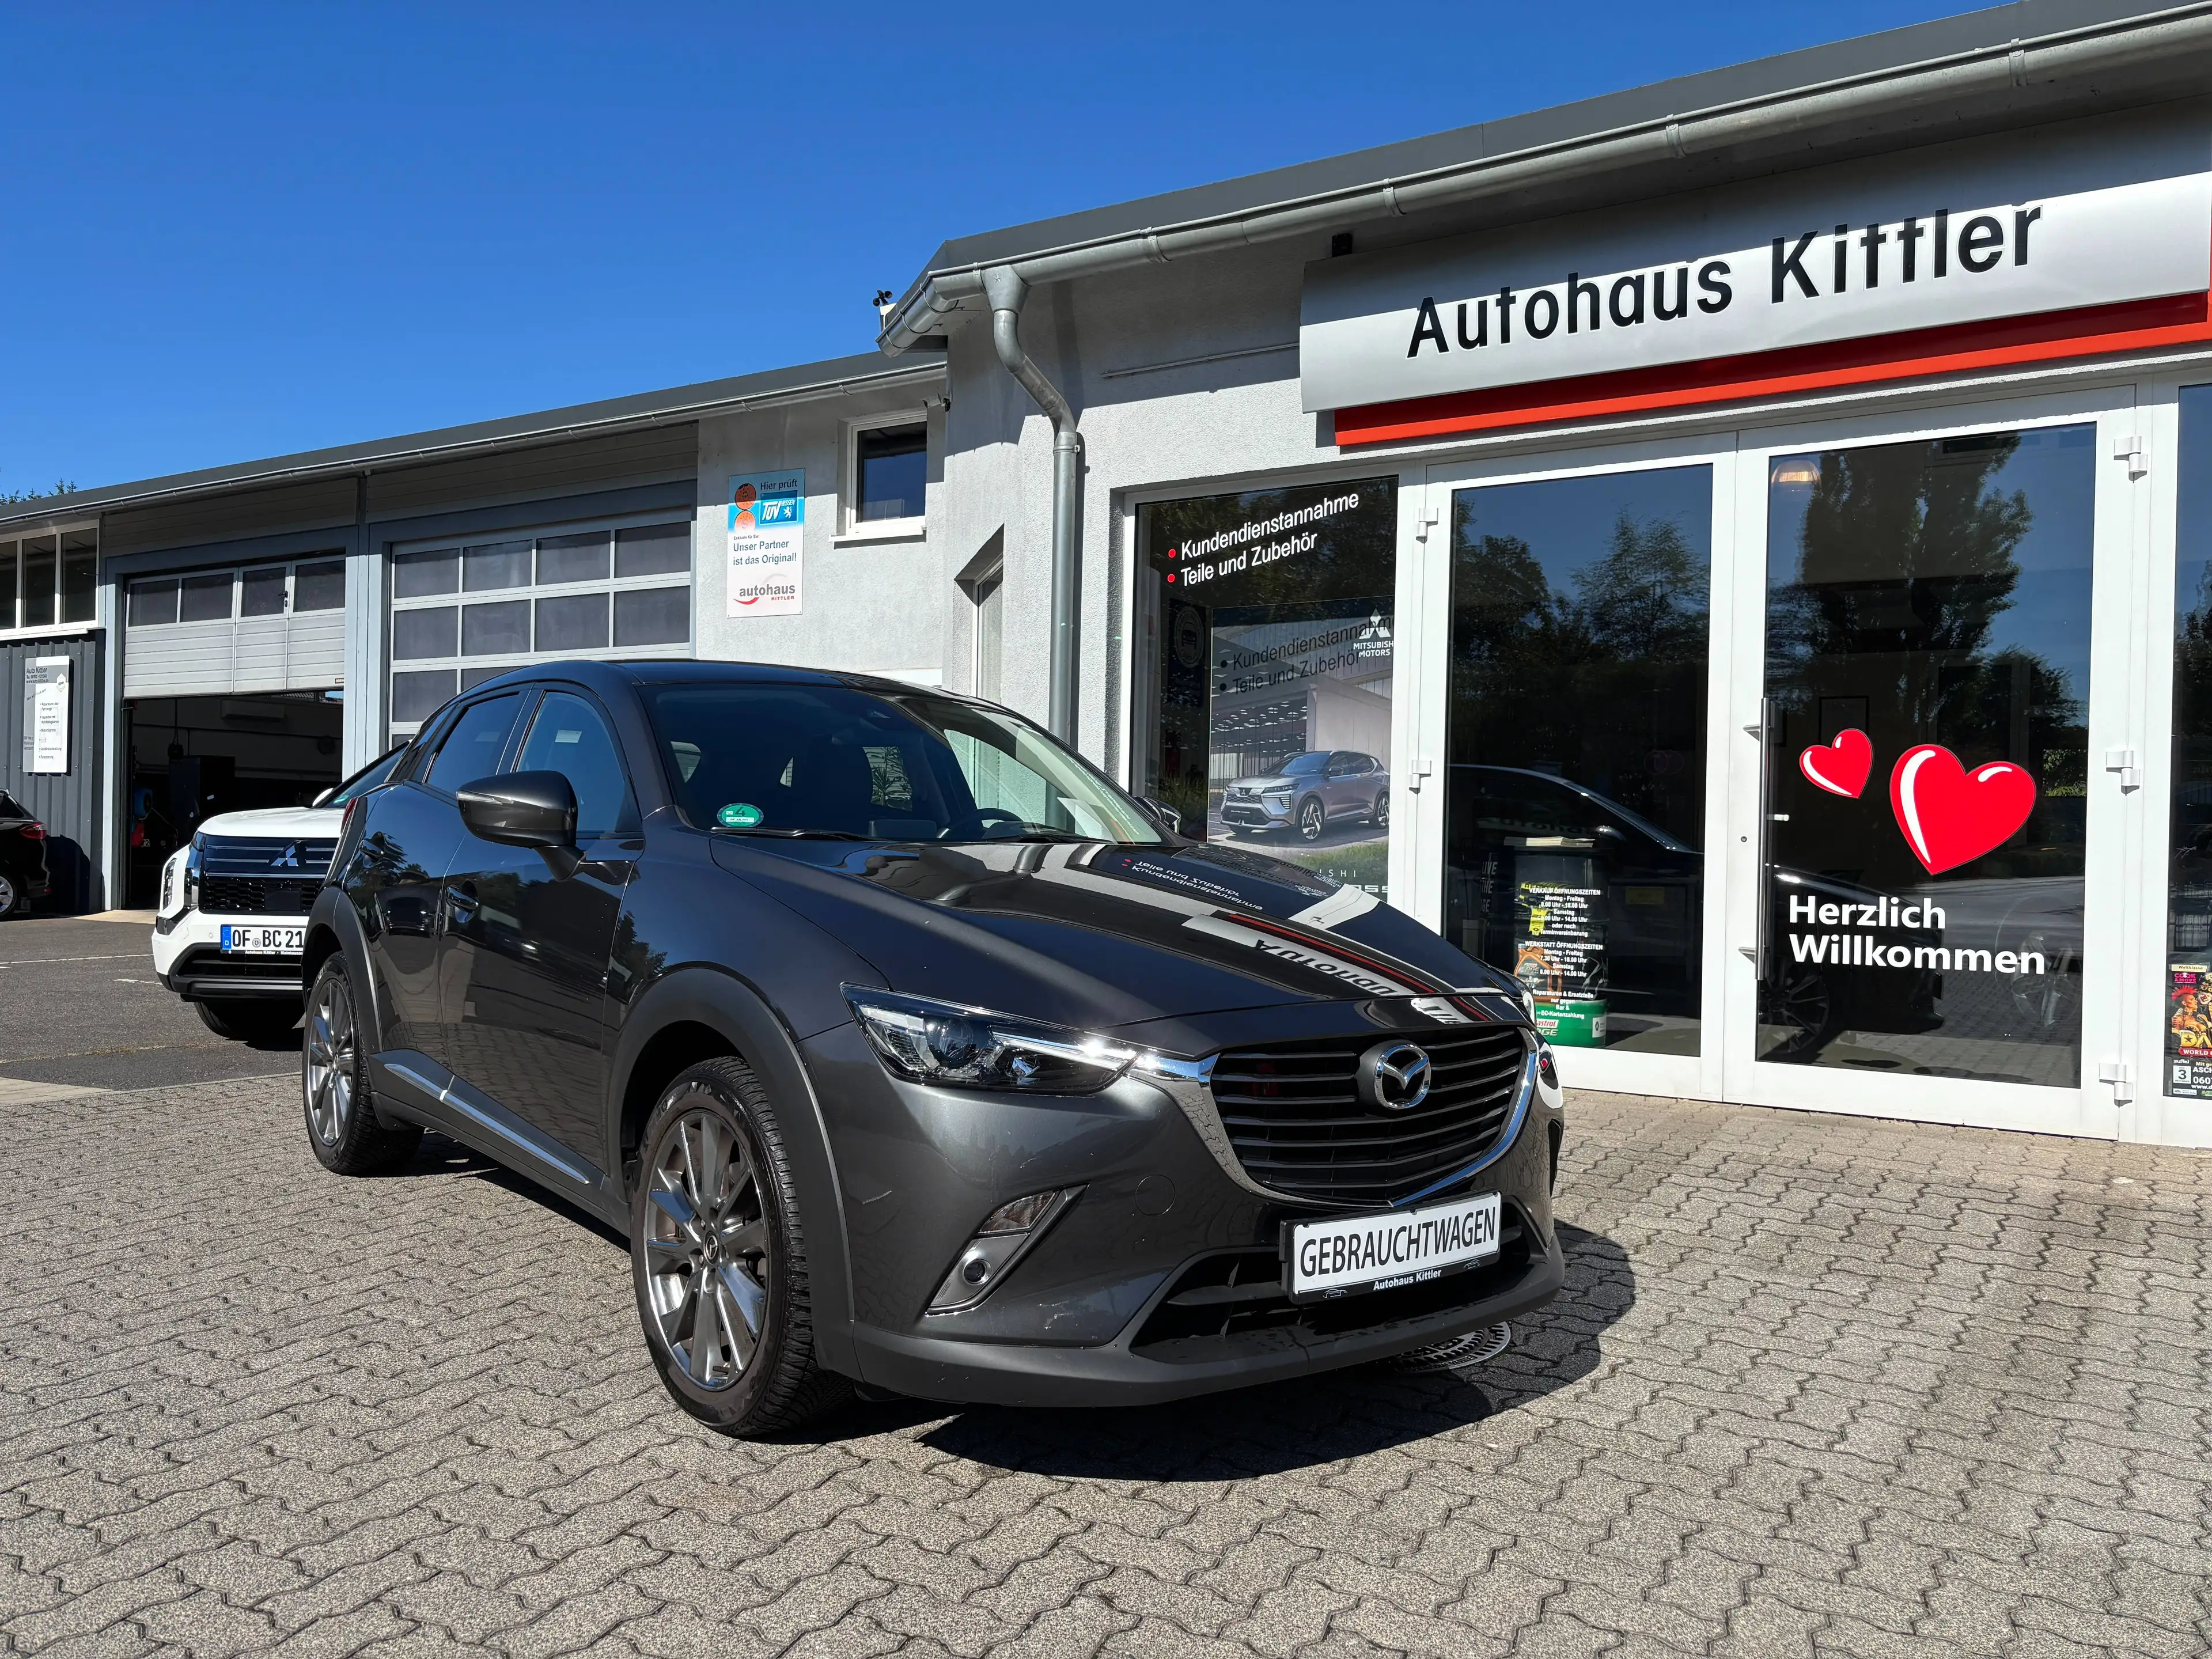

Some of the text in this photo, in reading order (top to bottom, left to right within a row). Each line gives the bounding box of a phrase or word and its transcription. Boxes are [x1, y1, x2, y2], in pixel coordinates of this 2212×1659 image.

[1406, 204, 2043, 359] Autohaus Kittler
[760, 478, 798, 491] Hier prüft
[1181, 493, 1359, 560] Kundendienstannahme
[733, 540, 790, 552] Unser Partner
[733, 552, 797, 566] ist das Original!
[1181, 532, 1318, 587] Teile und Zubehör
[739, 584, 796, 597] autohaus
[1353, 639, 1393, 650] MITSUBISH
[1358, 648, 1391, 658] MOTORS
[735, 806, 747, 816] 4
[1555, 887, 1601, 895] ÖFFNUNGSZEITEN
[1789, 895, 1946, 929] Herzlich
[232, 929, 251, 948] OF
[262, 930, 282, 948] BC
[1556, 941, 1603, 950] ÖFFNUNGSZEITEN
[1789, 934, 2045, 975] Willkommen
[1532, 989, 1562, 997] Reparaturen
[1541, 1010, 1585, 1020] EC-Kartenzahlung
[2178, 1069, 2187, 1080] 3
[1300, 1206, 1496, 1277] GEBRAUCHTWAGEN
[1373, 1268, 1442, 1291] Autohaus Kittler
